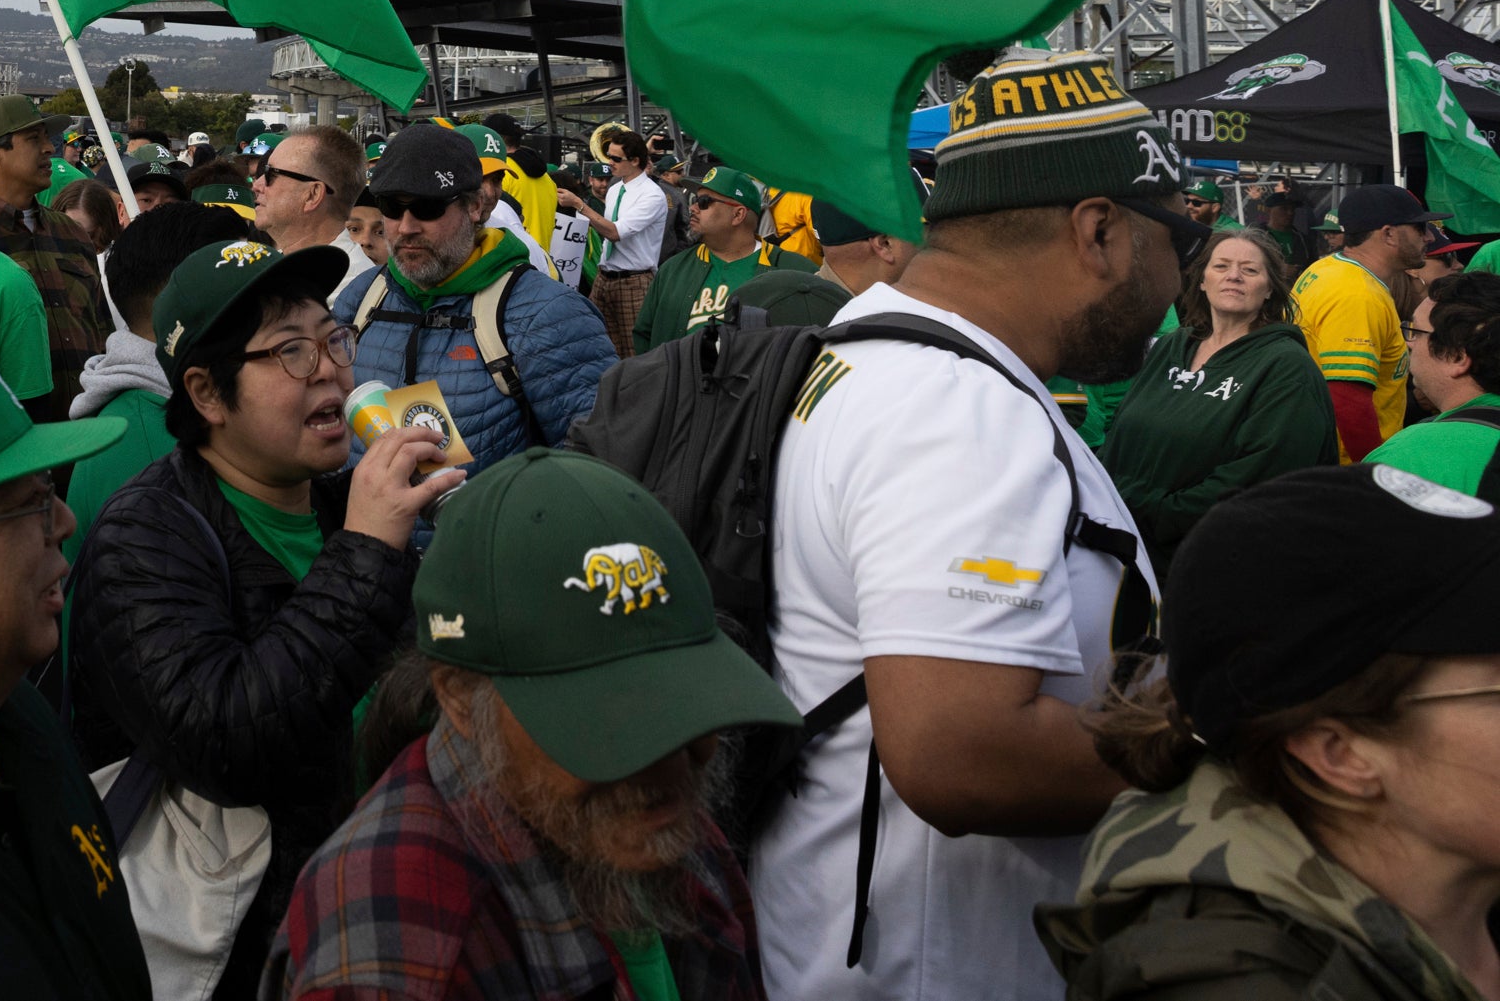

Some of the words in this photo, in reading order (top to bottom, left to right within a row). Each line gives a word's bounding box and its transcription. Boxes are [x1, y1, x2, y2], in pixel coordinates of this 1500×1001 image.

[991, 66, 1124, 116] ATHLE
[434, 170, 455, 189] A's
[405, 405, 425, 428] CHOOLS
[947, 586, 1045, 611] CHEVROLET
